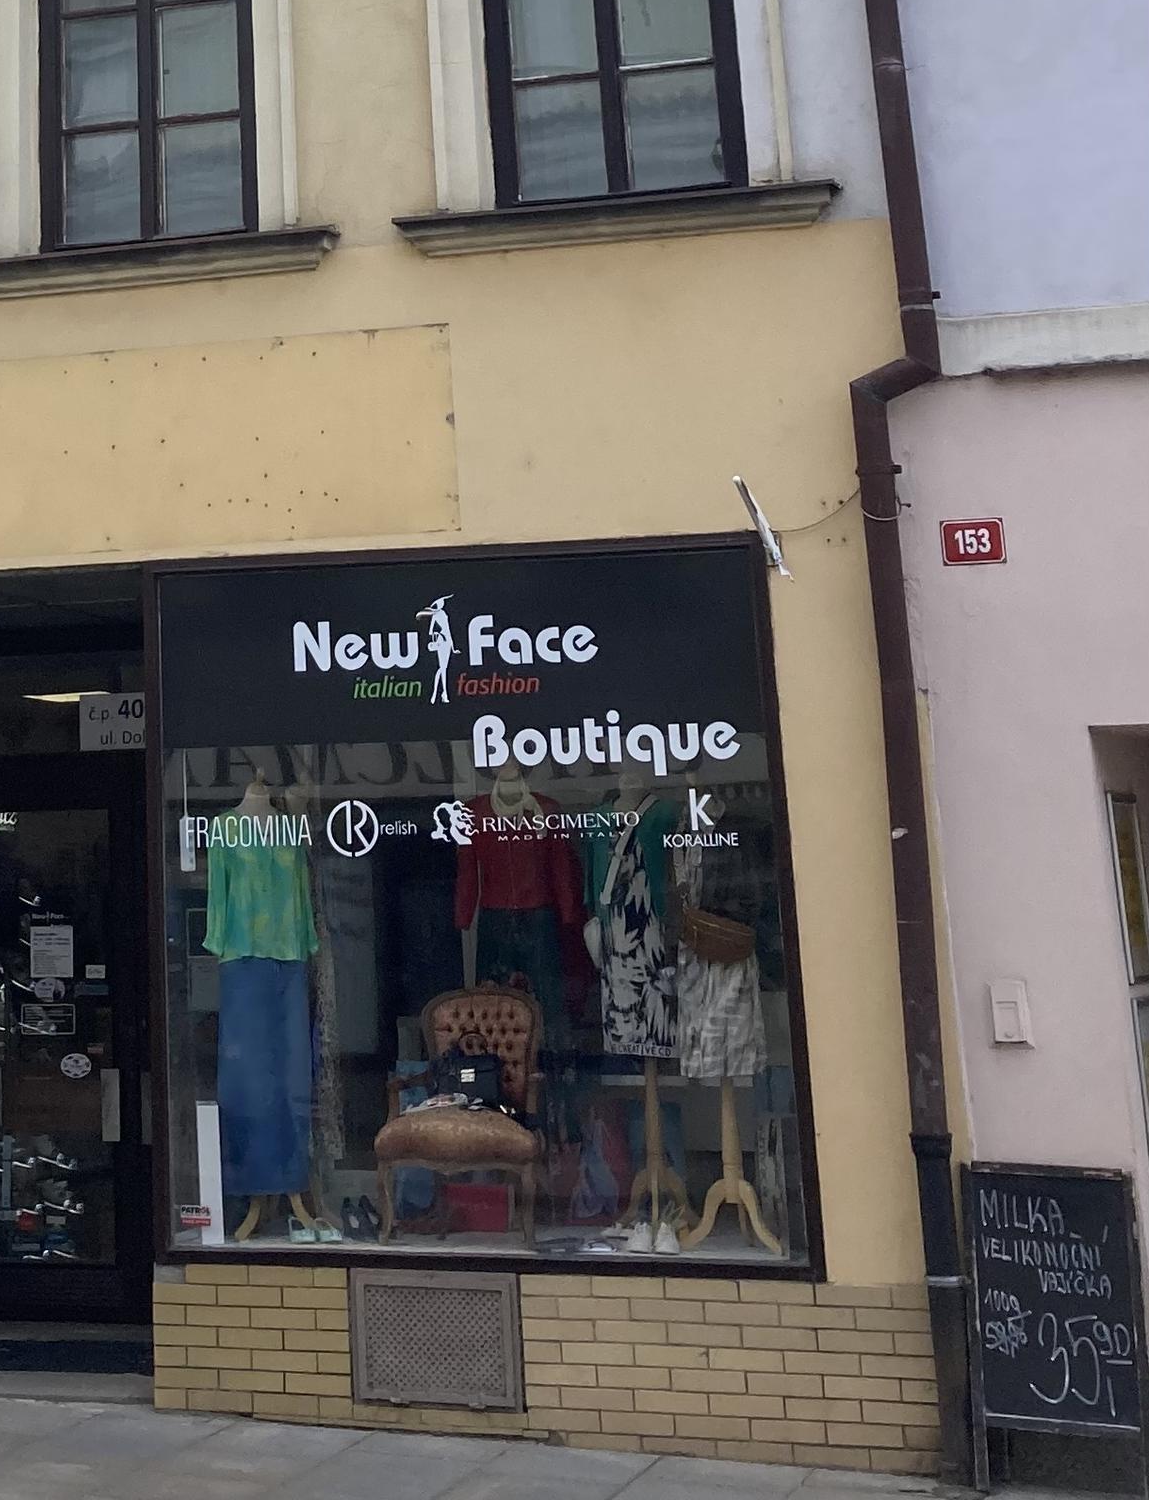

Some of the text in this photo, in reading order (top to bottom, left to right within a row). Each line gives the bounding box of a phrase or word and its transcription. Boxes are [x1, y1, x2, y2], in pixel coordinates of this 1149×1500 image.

[954, 528, 991, 554] 153
[293, 614, 599, 672] New Face
[353, 672, 540, 699] italian fashion
[473, 709, 741, 777] Boutique
[185, 814, 312, 848] FRACOMINA
[380, 820, 417, 837] relish
[482, 811, 641, 833] RINASCIMENTO
[662, 832, 739, 848] KORALLINE
[497, 830, 627, 842] MADE IN ITALY
[979, 1188, 1065, 1236] MILKA
